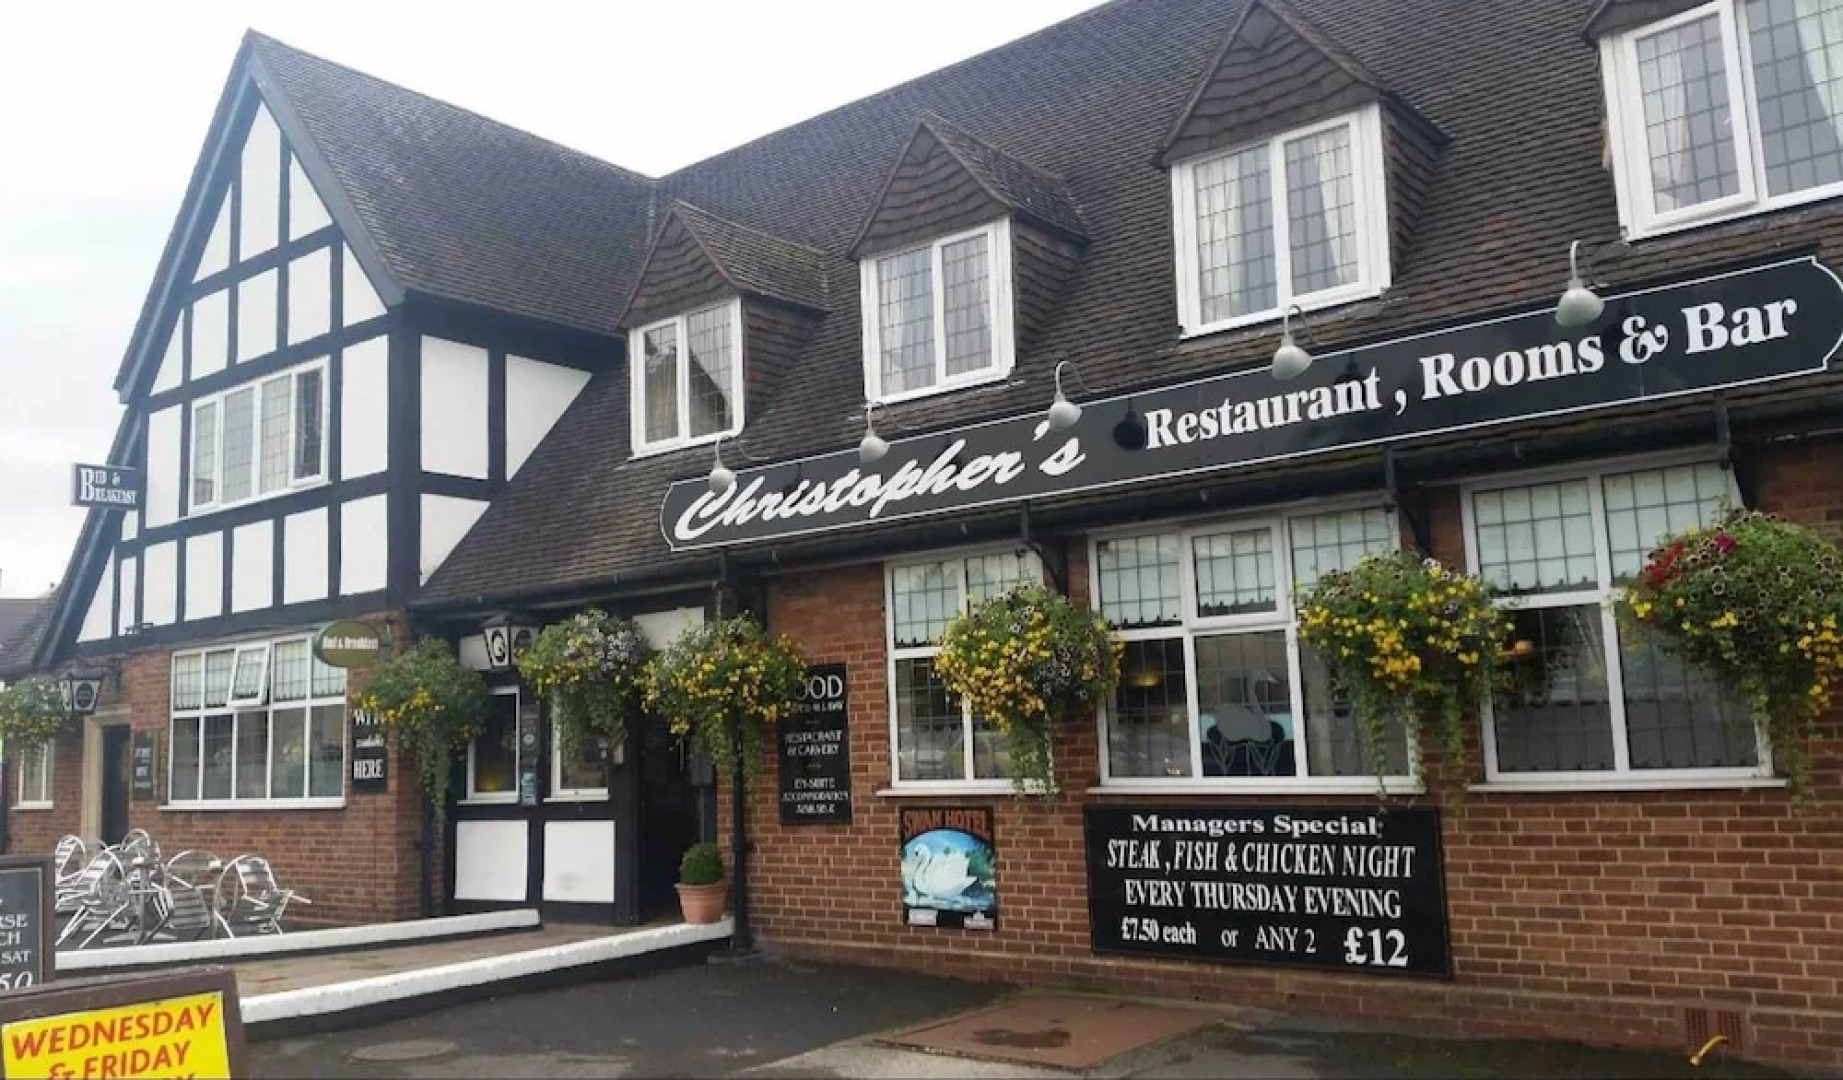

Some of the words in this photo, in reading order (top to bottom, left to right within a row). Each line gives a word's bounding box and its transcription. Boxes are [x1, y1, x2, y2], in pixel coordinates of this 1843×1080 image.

[674, 420, 1086, 540] Christopher's
[1145, 366, 1383, 451] Restaurant
[1419, 333, 1604, 401] Rooms
[1619, 315, 1668, 364] &
[1681, 298, 1797, 354] Bar
[793, 675, 843, 699] OOD
[353, 759, 384, 780] HERE
[1132, 814, 1265, 837] Managers
[1273, 815, 1379, 839] Special
[1107, 839, 1162, 869] STEAK
[1174, 841, 1218, 872] FISH
[1225, 842, 1238, 873] &
[1243, 843, 1336, 876] CHICKEN
[1342, 846, 1416, 878] NIGHT
[1124, 879, 1186, 907] EVERY
[1190, 882, 1299, 914] THURSDAY
[1304, 886, 1402, 919] EVENING
[1121, 916, 1160, 942] £7.50
[1162, 921, 1197, 945] each
[1221, 929, 1239, 948] or
[1254, 926, 1299, 952] ANY
[1305, 929, 1317, 954] 2
[1343, 926, 1409, 967] £12
[10, 1001, 215, 1060] WEDNESDAY
[83, 1040, 191, 1080] FRIDAY
